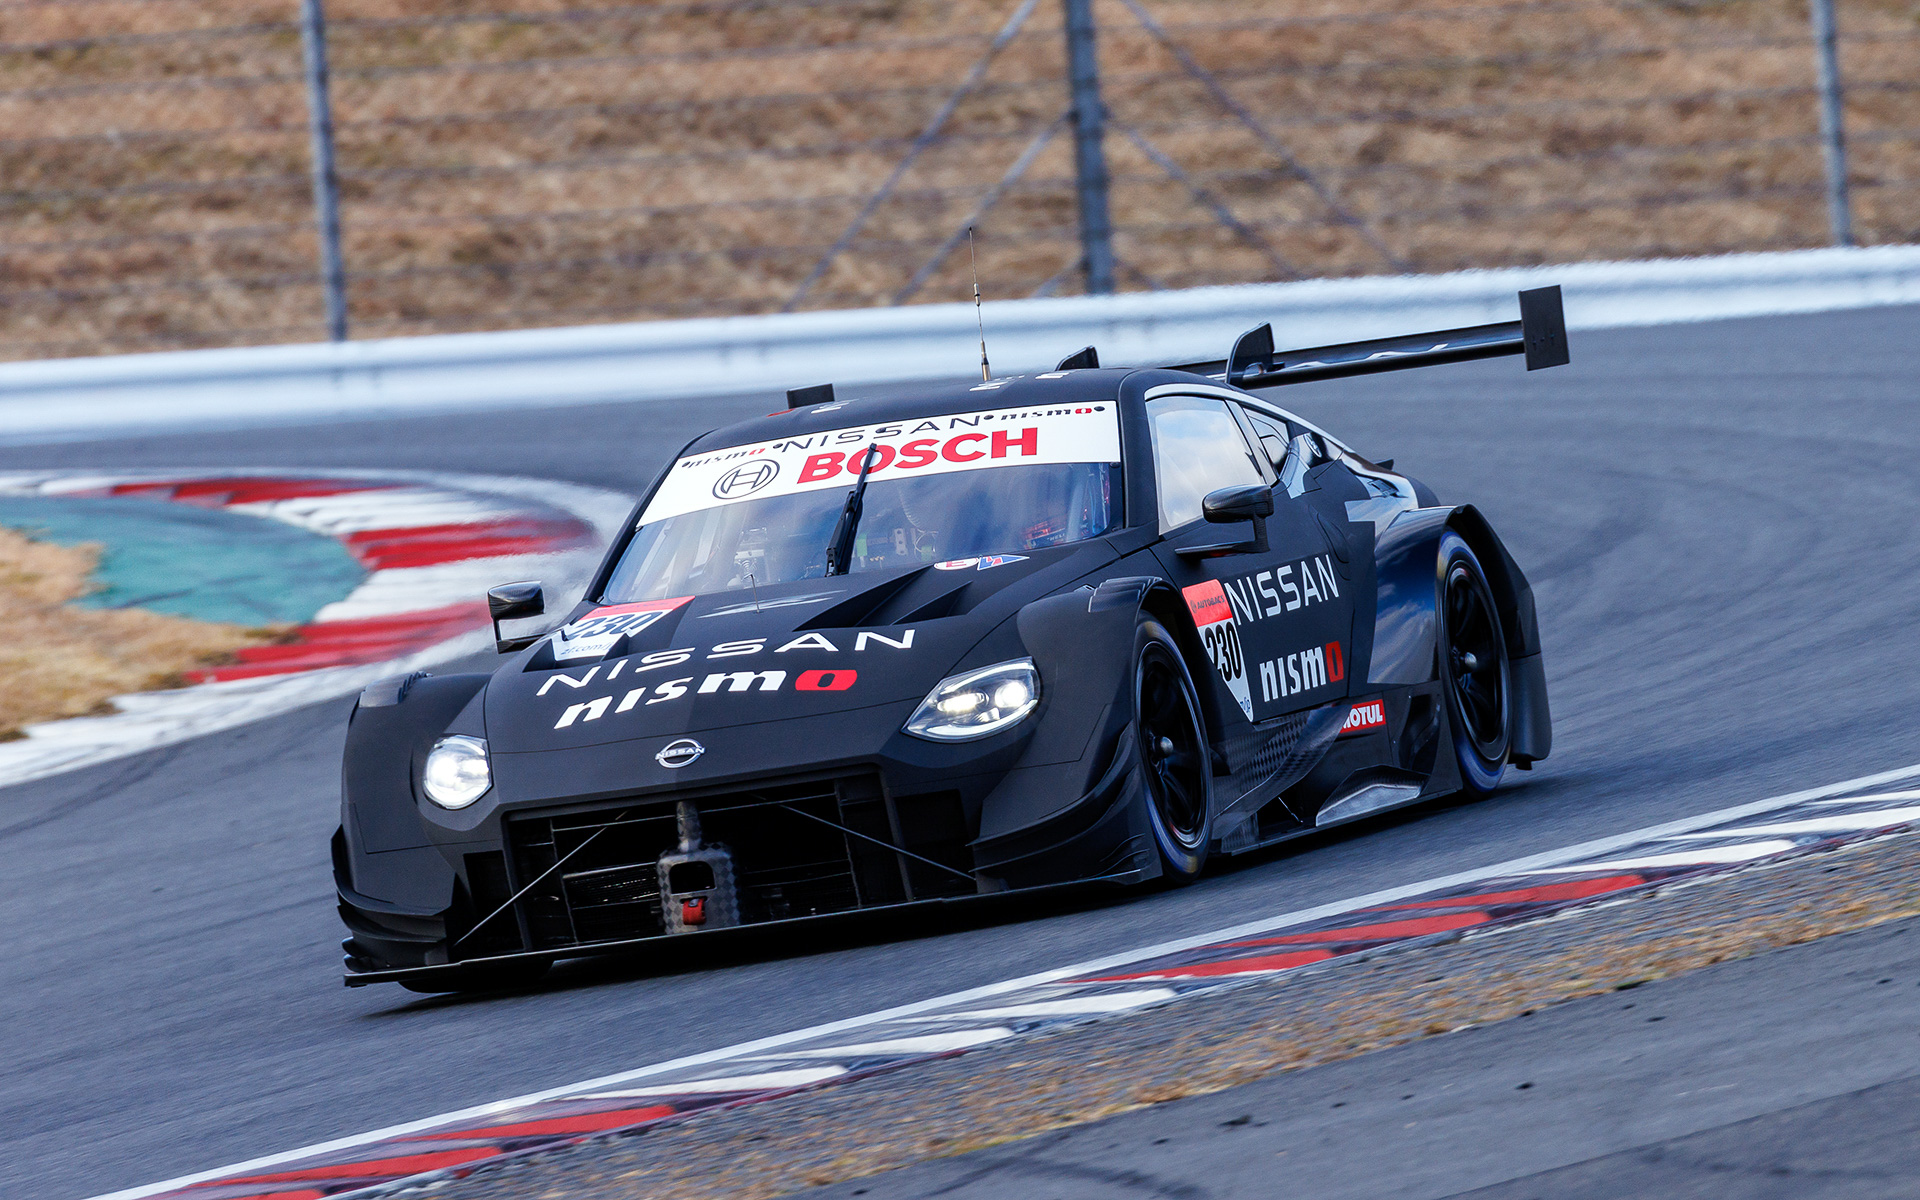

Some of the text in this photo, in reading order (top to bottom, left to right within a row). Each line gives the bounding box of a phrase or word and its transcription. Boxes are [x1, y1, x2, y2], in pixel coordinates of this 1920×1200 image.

[782, 415, 980, 453] NISSAN
[1001, 408, 1092, 421] nismo
[688, 448, 766, 468] nismo
[797, 427, 1038, 484] BOSCH
[1224, 554, 1339, 626] NISSAN
[566, 611, 664, 641] 230
[1205, 621, 1242, 682] 230
[536, 629, 916, 696] NISSAN
[1259, 640, 1345, 702] nismo
[554, 669, 858, 729] nismo
[655, 747, 705, 760] NISSAN
